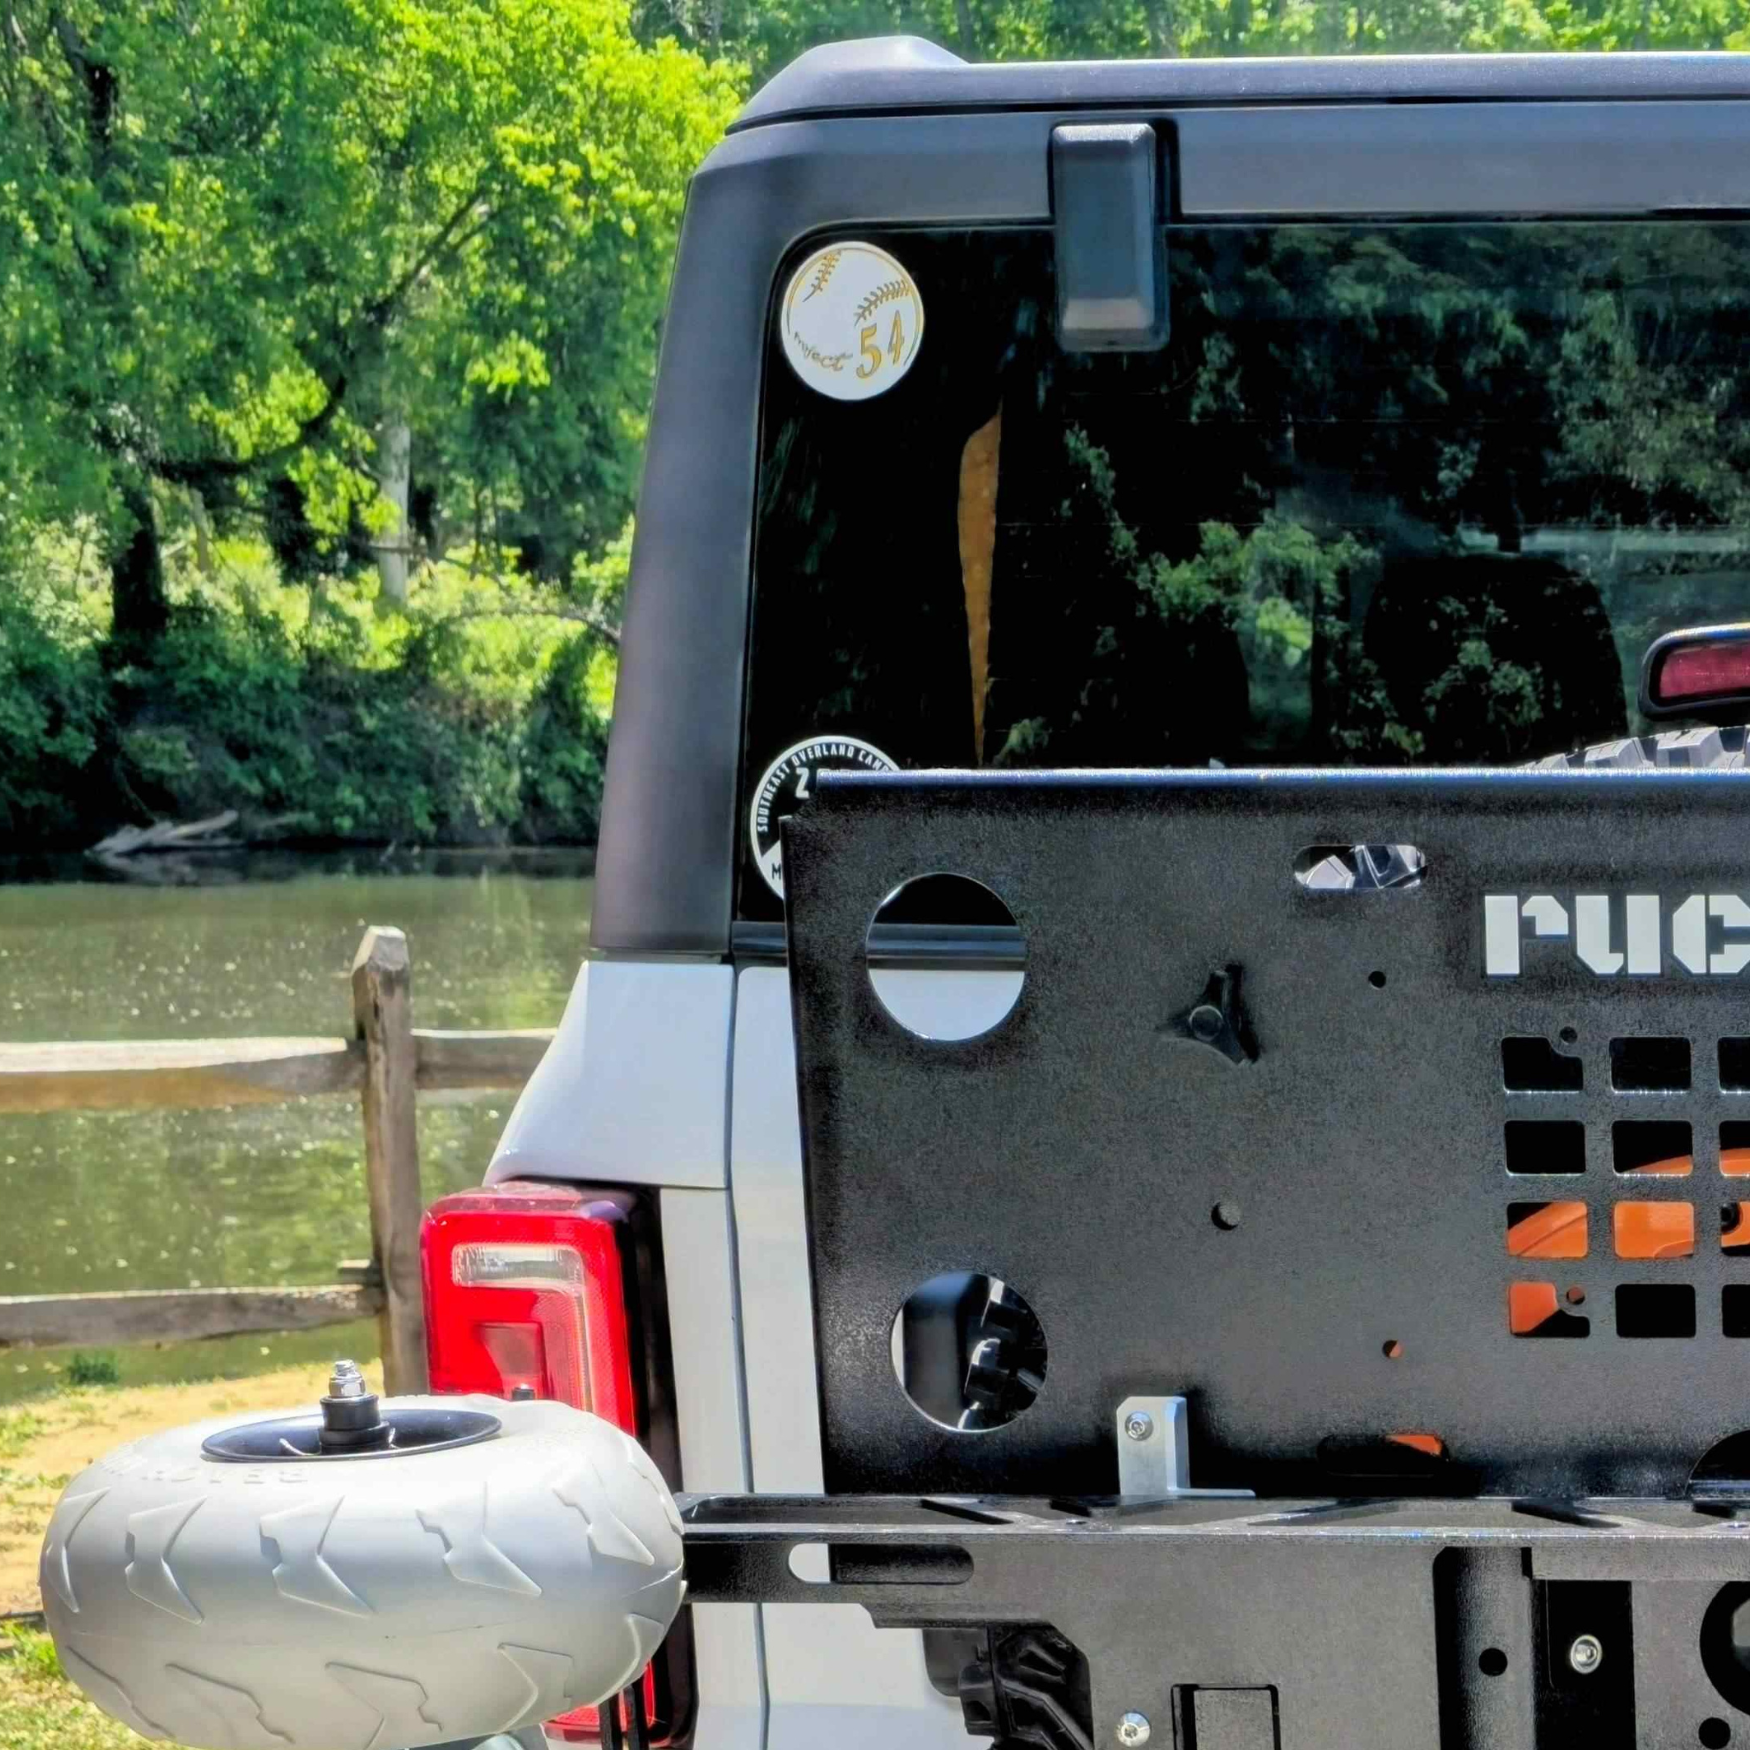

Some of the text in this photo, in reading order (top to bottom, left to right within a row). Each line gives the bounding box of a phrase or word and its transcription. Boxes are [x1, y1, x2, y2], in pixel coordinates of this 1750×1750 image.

[856, 309, 905, 379] 54
[757, 762, 790, 832] SOUTHEAST
[791, 743, 855, 767] OVERLAND
